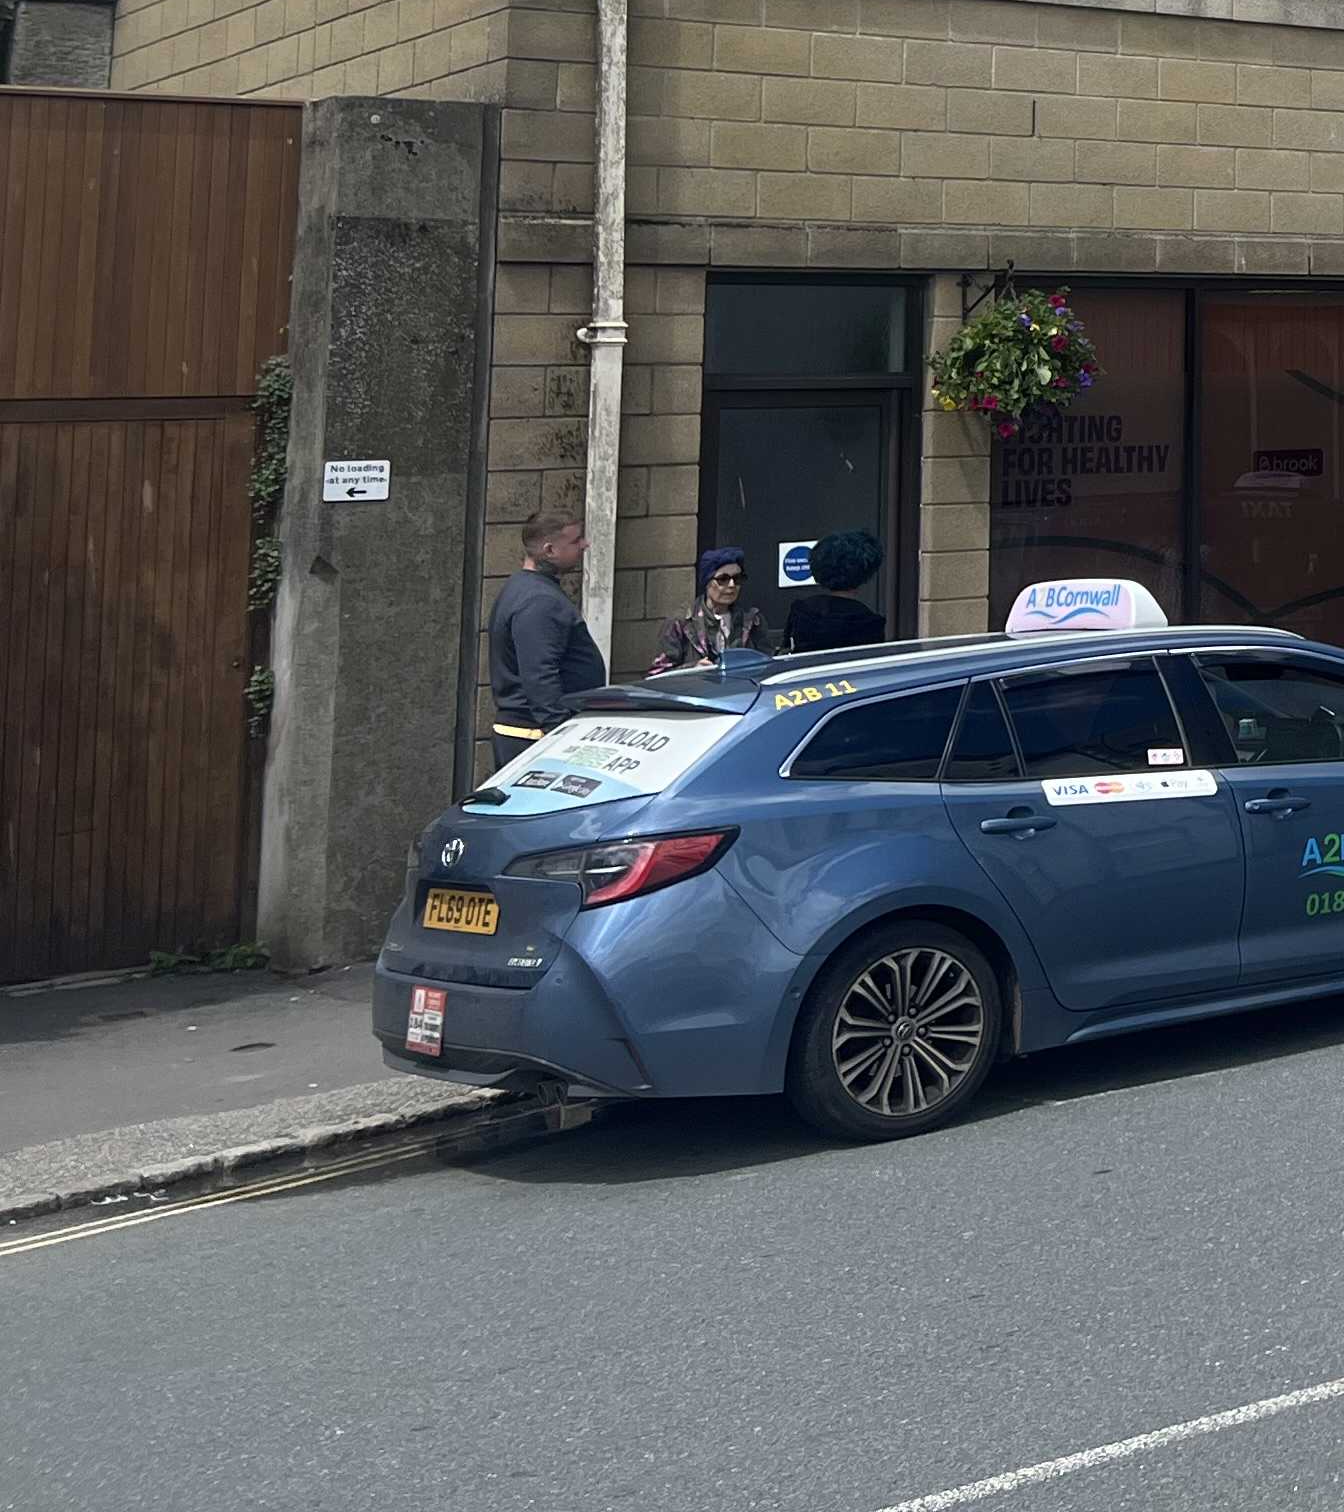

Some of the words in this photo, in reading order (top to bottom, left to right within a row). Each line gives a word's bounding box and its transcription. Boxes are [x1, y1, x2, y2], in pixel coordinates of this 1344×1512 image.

[1002, 415, 1122, 444] IGHTING
[330, 464, 345, 473] No
[347, 464, 385, 473] loading
[1002, 447, 1054, 477] FOR
[1061, 445, 1170, 474] HEALTHY
[1273, 455, 1319, 472] brook
[329, 476, 339, 484] at
[342, 477, 360, 486] any
[363, 475, 385, 484] time
[1002, 478, 1072, 508] LIVES
[1057, 584, 1121, 608] Cornwall
[775, 687, 823, 712] A2B
[825, 679, 857, 697] 11
[580, 725, 670, 753] DOWNLOAD
[604, 756, 640, 774] APP
[1052, 783, 1089, 796] VISA
[429, 893, 465, 924] FL69
[465, 898, 495, 927] OTE
